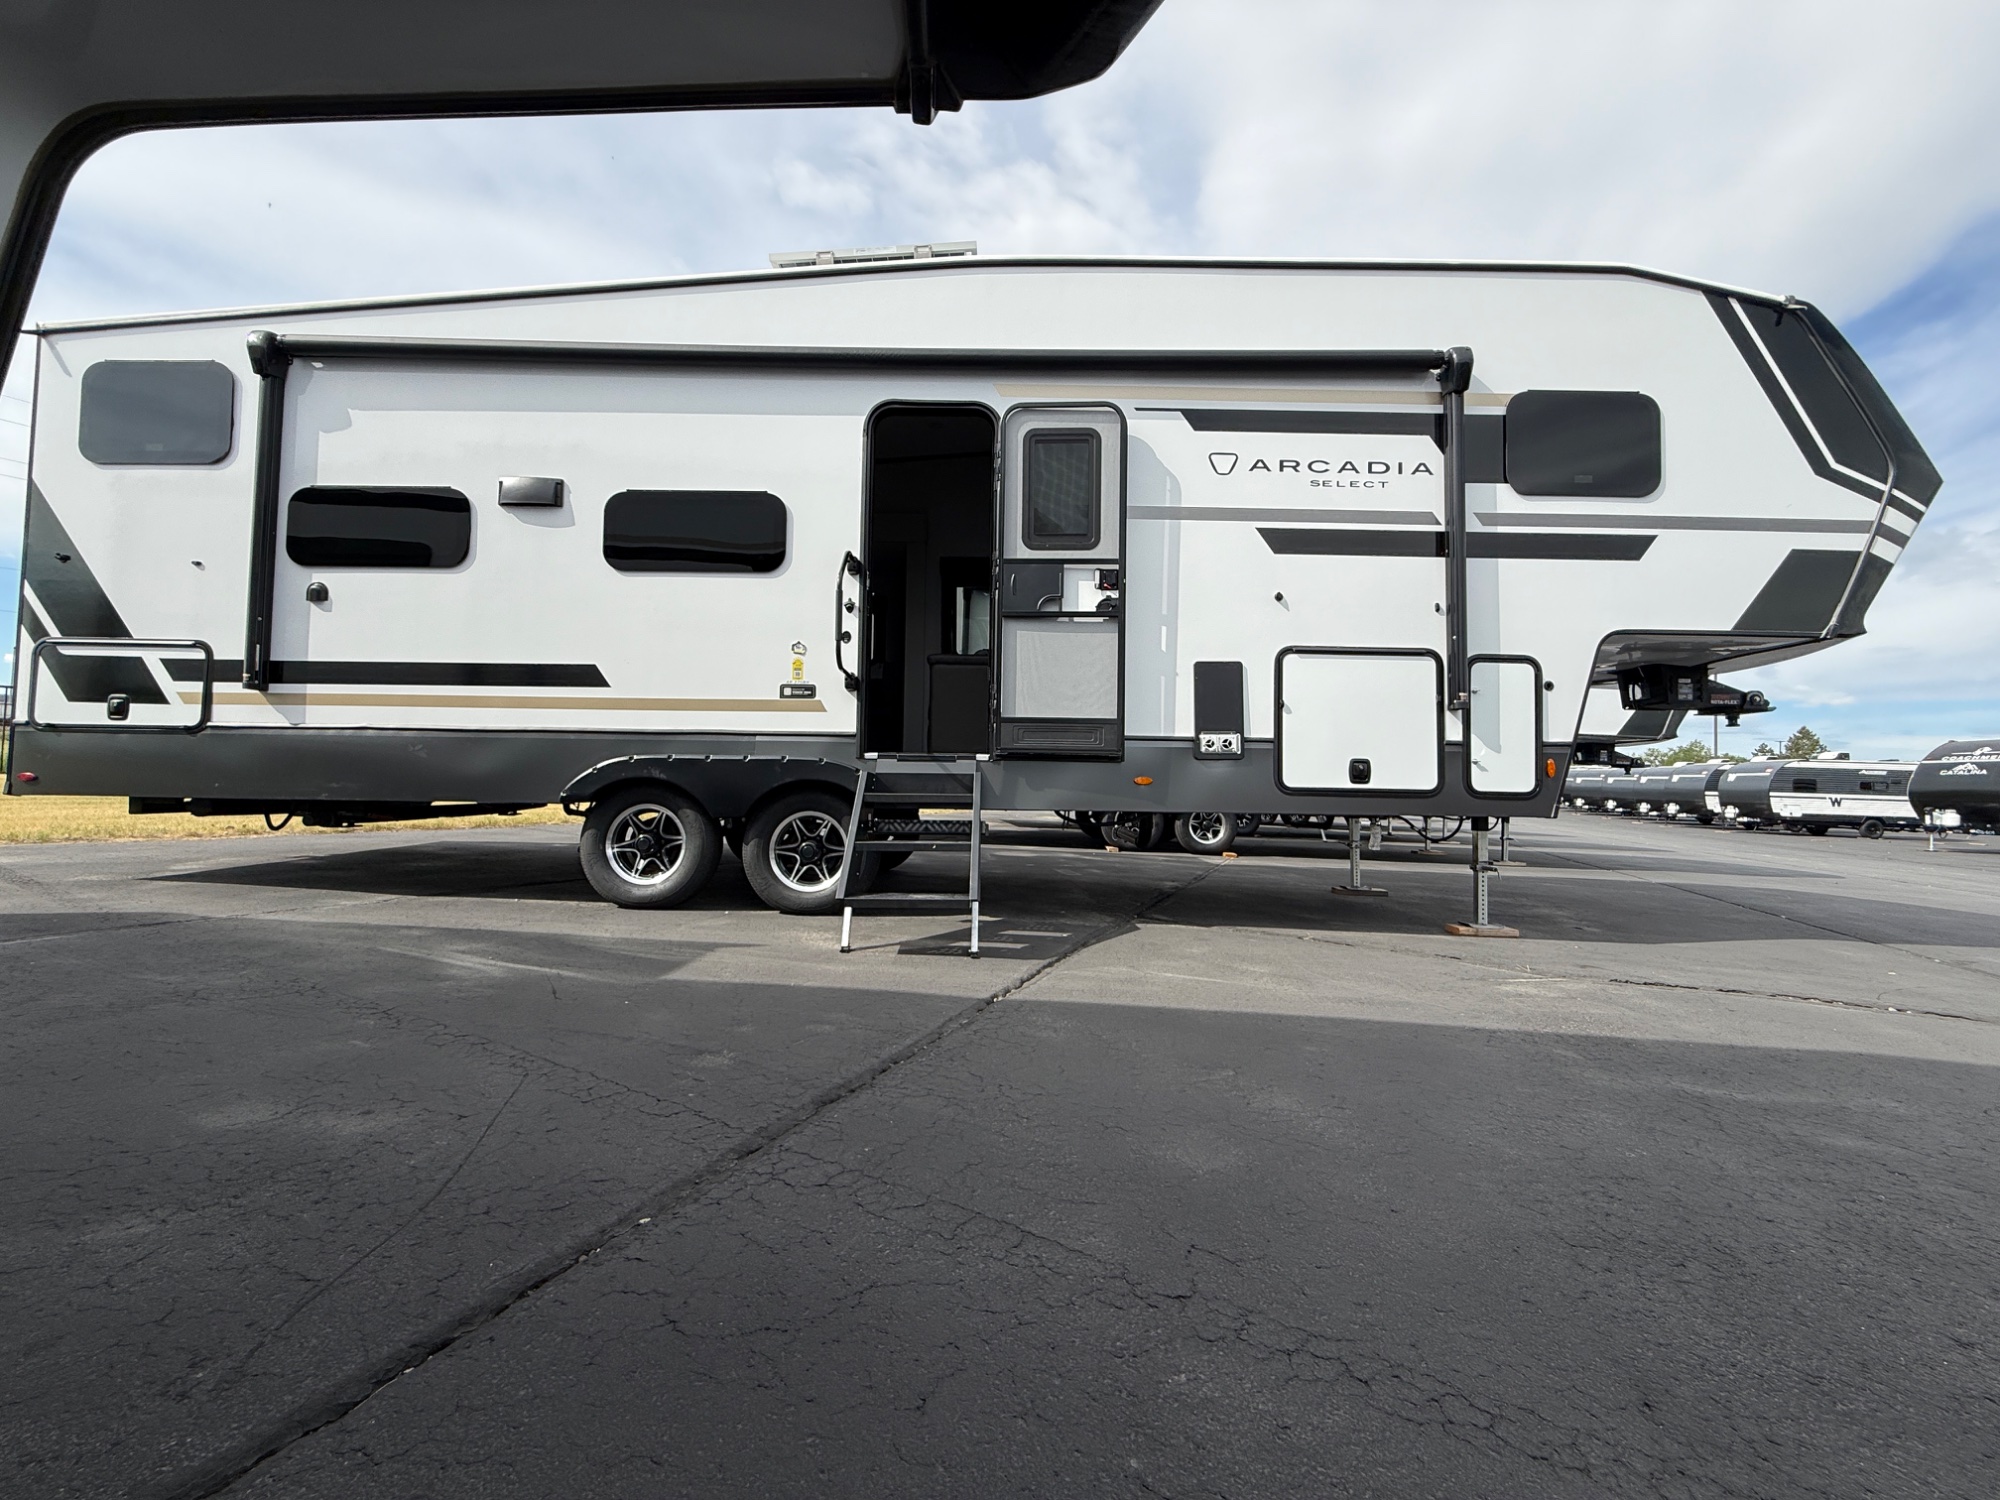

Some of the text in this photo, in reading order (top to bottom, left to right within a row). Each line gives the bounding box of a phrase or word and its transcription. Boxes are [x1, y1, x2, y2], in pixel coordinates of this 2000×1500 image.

[1248, 458, 1435, 476] ARCADIA
[1309, 479, 1389, 489] SELECT
[1828, 797, 1843, 807] W
